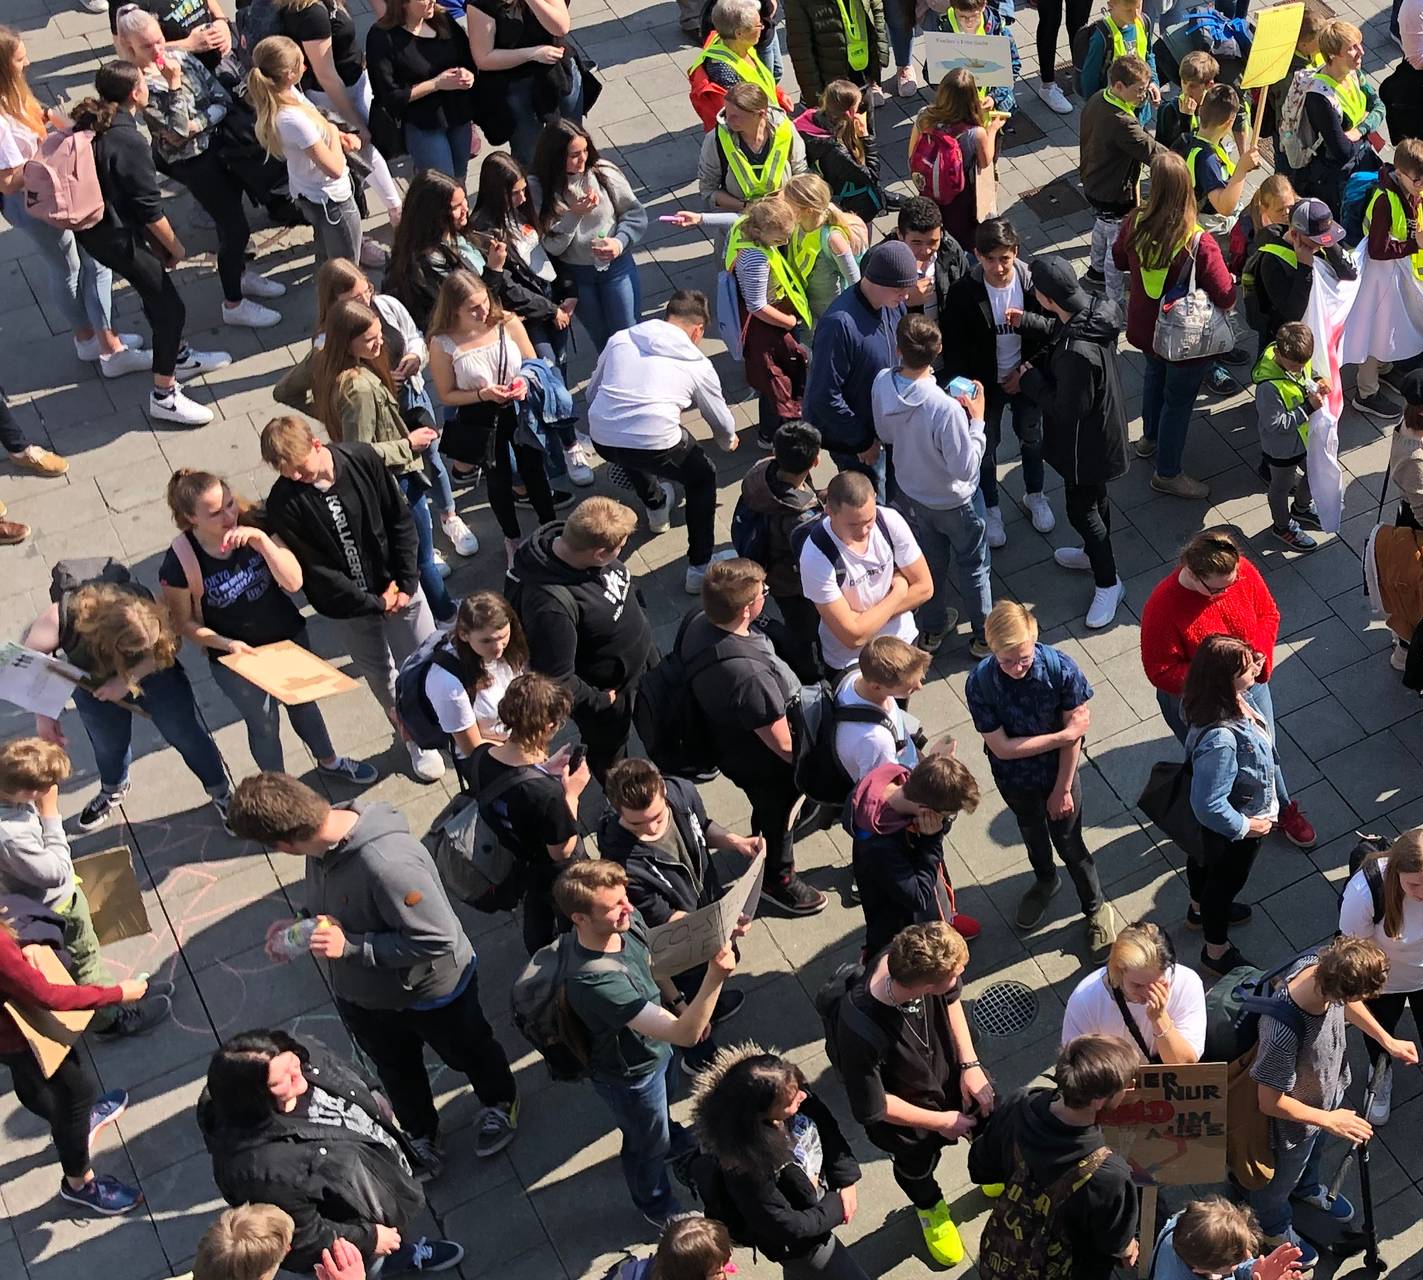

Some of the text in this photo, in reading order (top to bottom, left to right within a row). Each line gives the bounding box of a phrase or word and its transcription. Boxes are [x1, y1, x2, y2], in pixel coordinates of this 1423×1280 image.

[326, 495, 369, 594] KARL LAGERFE
[202, 569, 231, 589] OKYO
[1136, 1072, 1178, 1089] ER
[1165, 1085, 1223, 1100] NUR
[1177, 1111, 1212, 1129] IM
